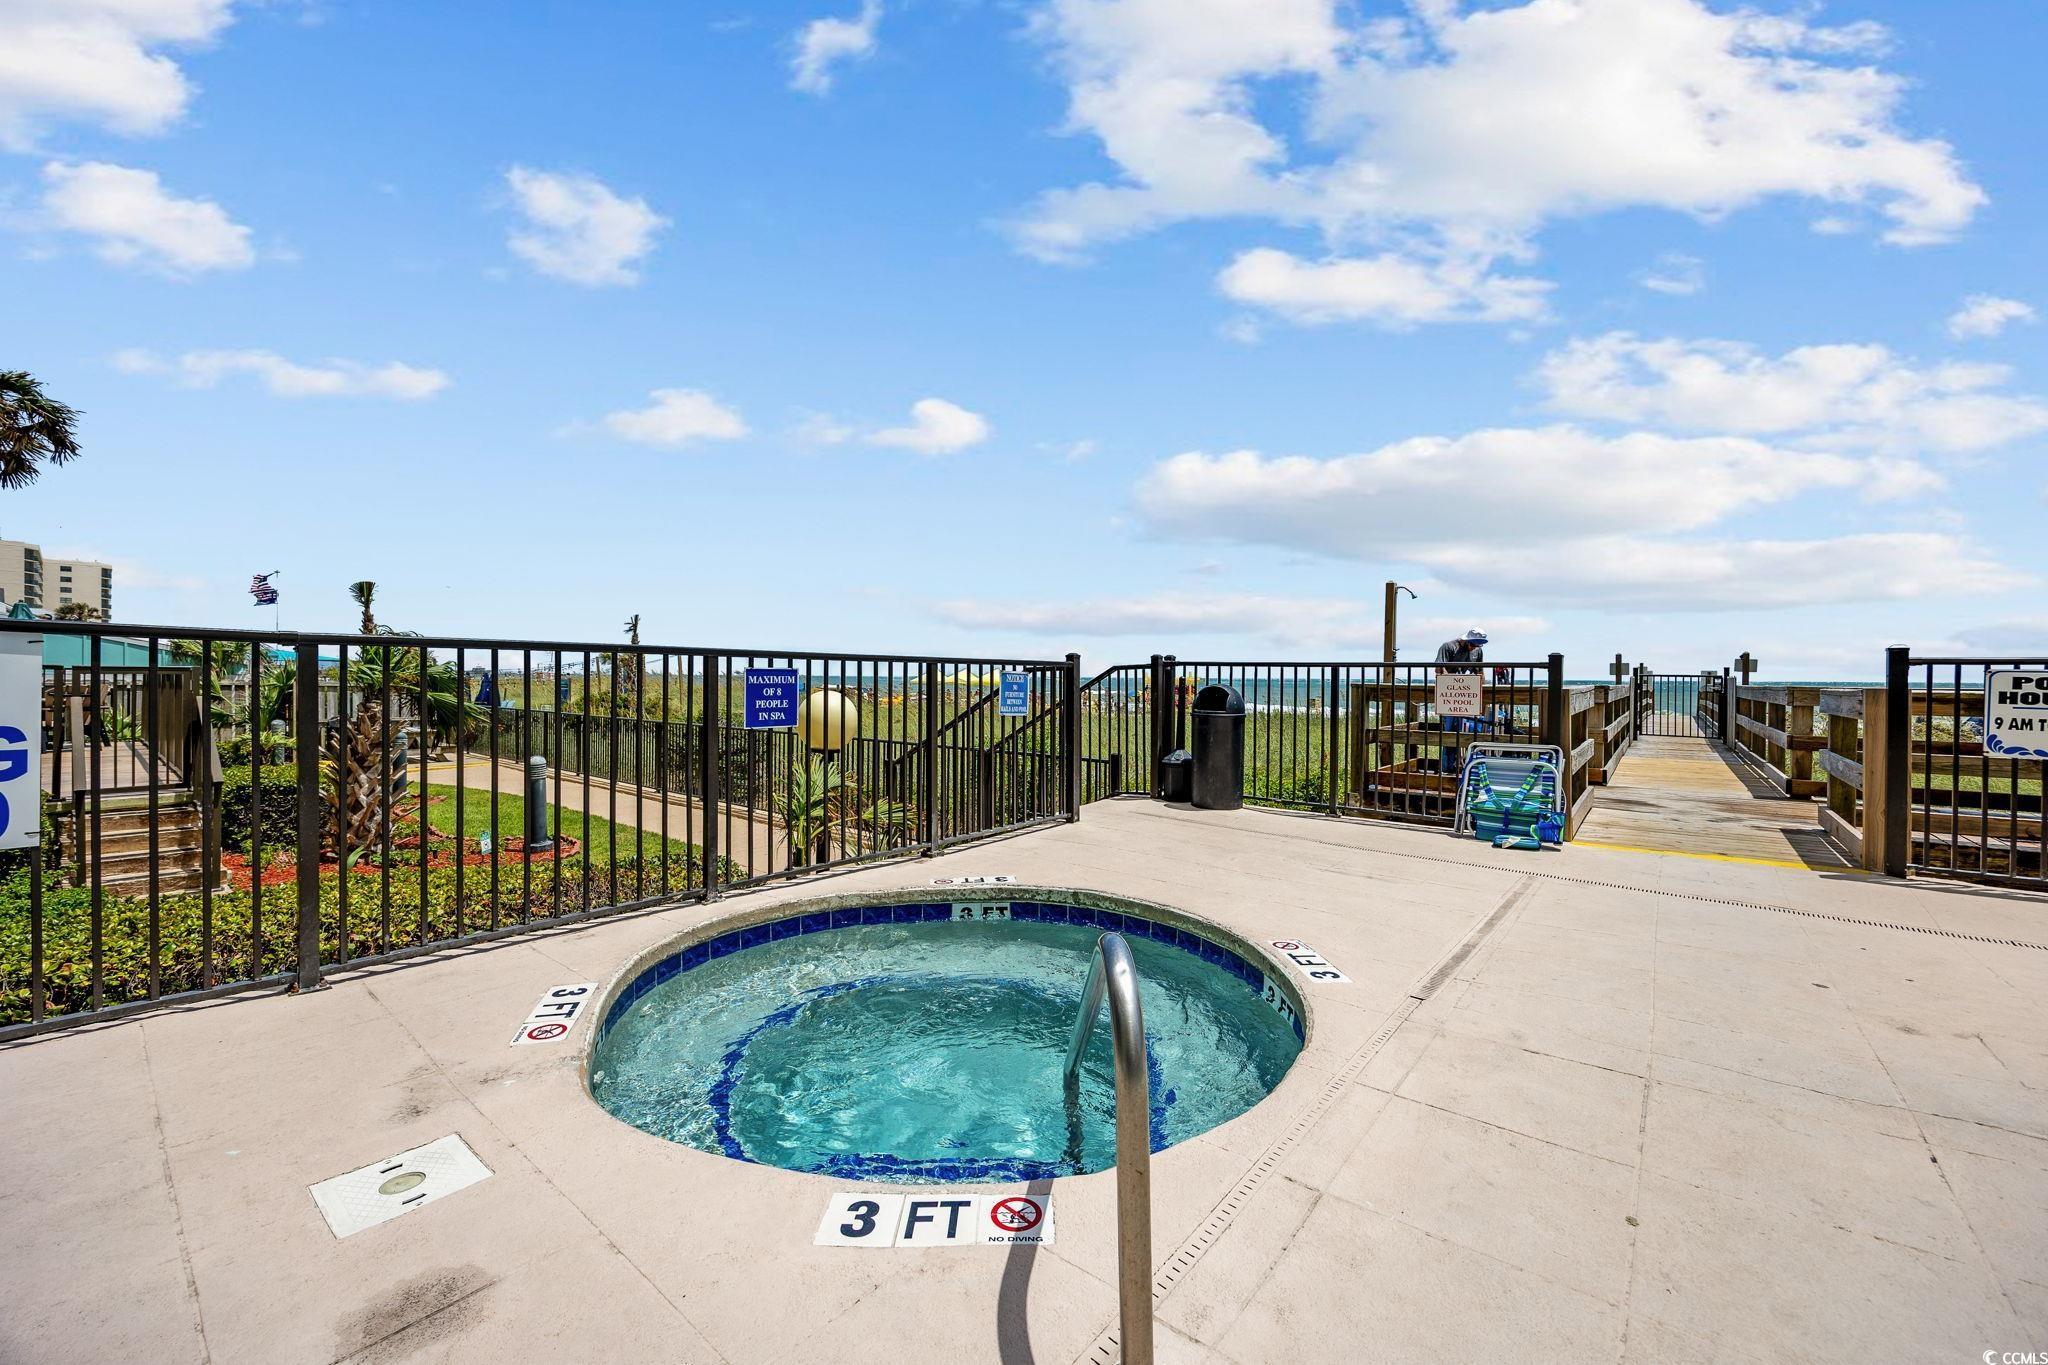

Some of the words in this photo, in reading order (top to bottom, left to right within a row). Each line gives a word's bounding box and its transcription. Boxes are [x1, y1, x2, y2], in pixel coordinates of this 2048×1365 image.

[748, 675, 796, 684] MAXIMUM
[763, 687, 776, 697] OF
[776, 687, 782, 696] 8
[755, 699, 789, 709] PEOPLE
[758, 712, 769, 720] IN
[770, 711, 786, 720] SPA
[1994, 717, 2004, 729] 9
[2008, 718, 2034, 731] AM
[960, 907, 973, 919] 3
[982, 906, 1009, 919] FT
[1287, 953, 1327, 966] FT
[1310, 971, 1341, 979] 3
[551, 987, 588, 998] 3
[535, 1001, 581, 1018] FT
[1265, 985, 1275, 1004] 3
[1278, 996, 1294, 1022] FT
[840, 1200, 880, 1238] 3
[903, 1200, 971, 1239] FT
